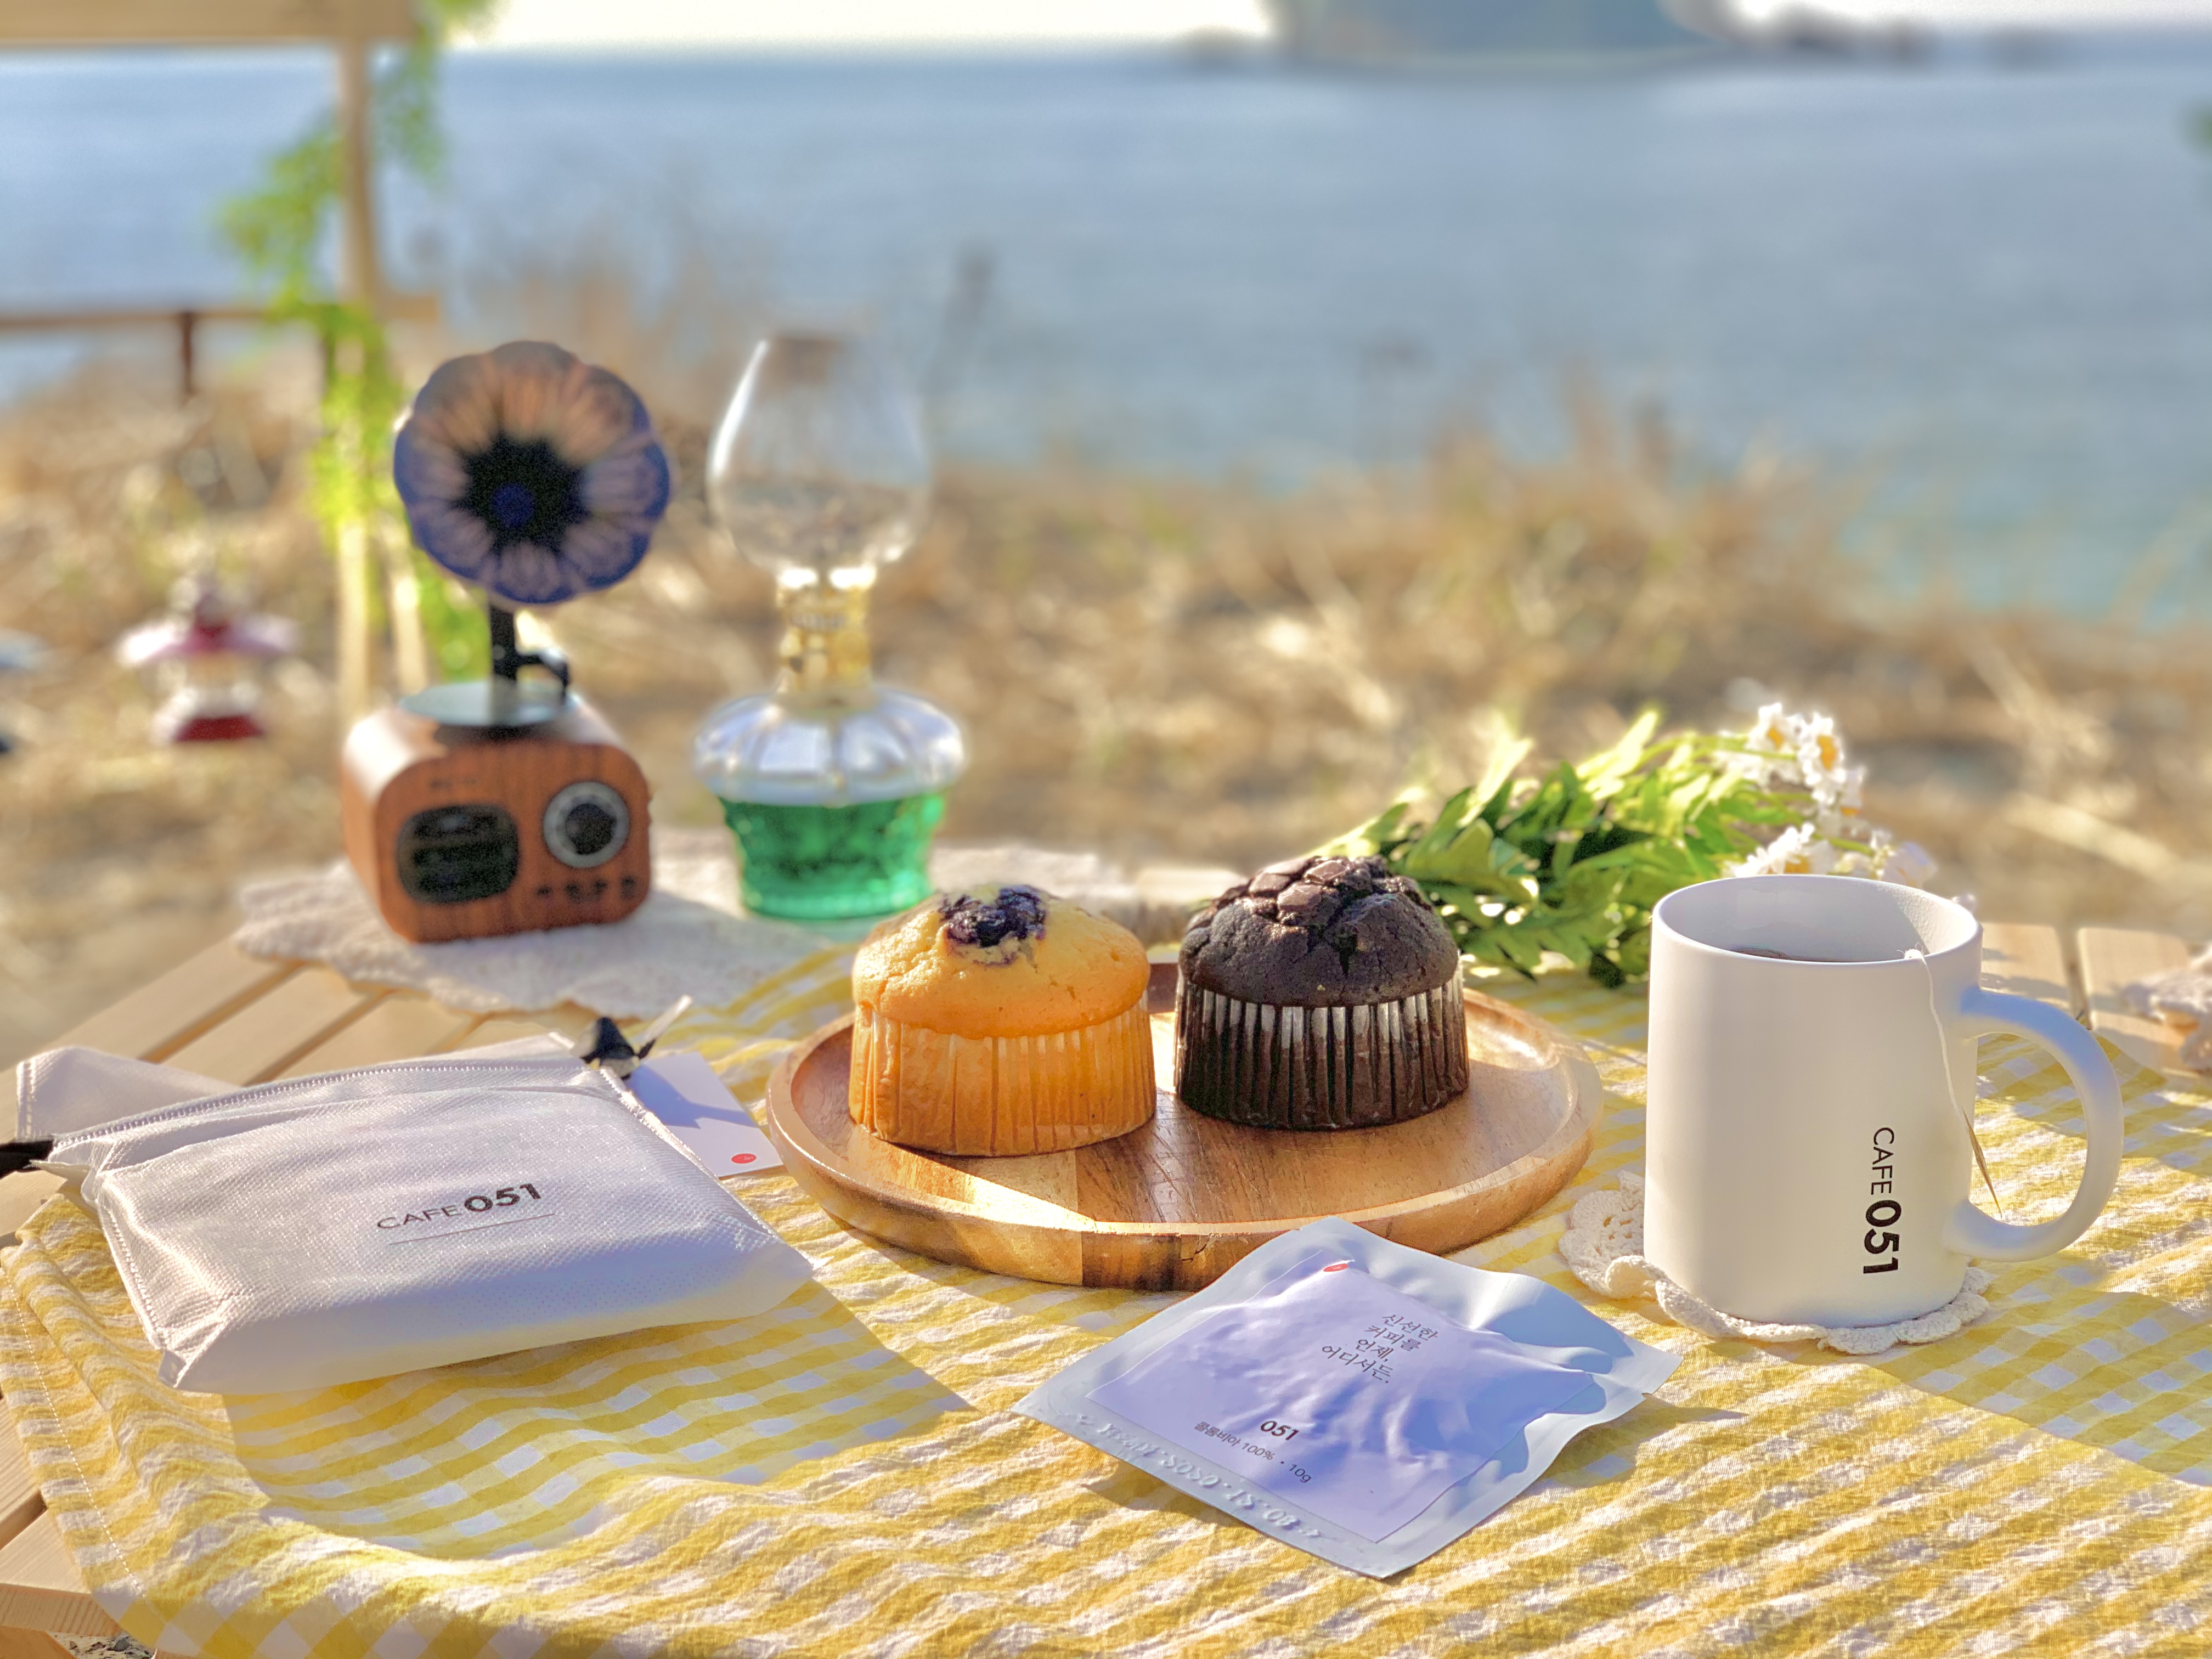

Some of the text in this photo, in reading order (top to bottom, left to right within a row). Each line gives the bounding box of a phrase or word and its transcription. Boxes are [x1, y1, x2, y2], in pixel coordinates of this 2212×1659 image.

[377, 1183, 542, 1229] CAFE 051
[1863, 1127, 1902, 1274] CAFE 051
[1364, 1325, 1421, 1352] 커피를
[1382, 1314, 1438, 1341] 신선한
[1322, 1345, 1393, 1384] 어디서든.
[1356, 1339, 1395, 1362] 언제,
[1260, 1420, 1300, 1441] 051
[1194, 1421, 1312, 1483] 콜롬비아 100% 10g
